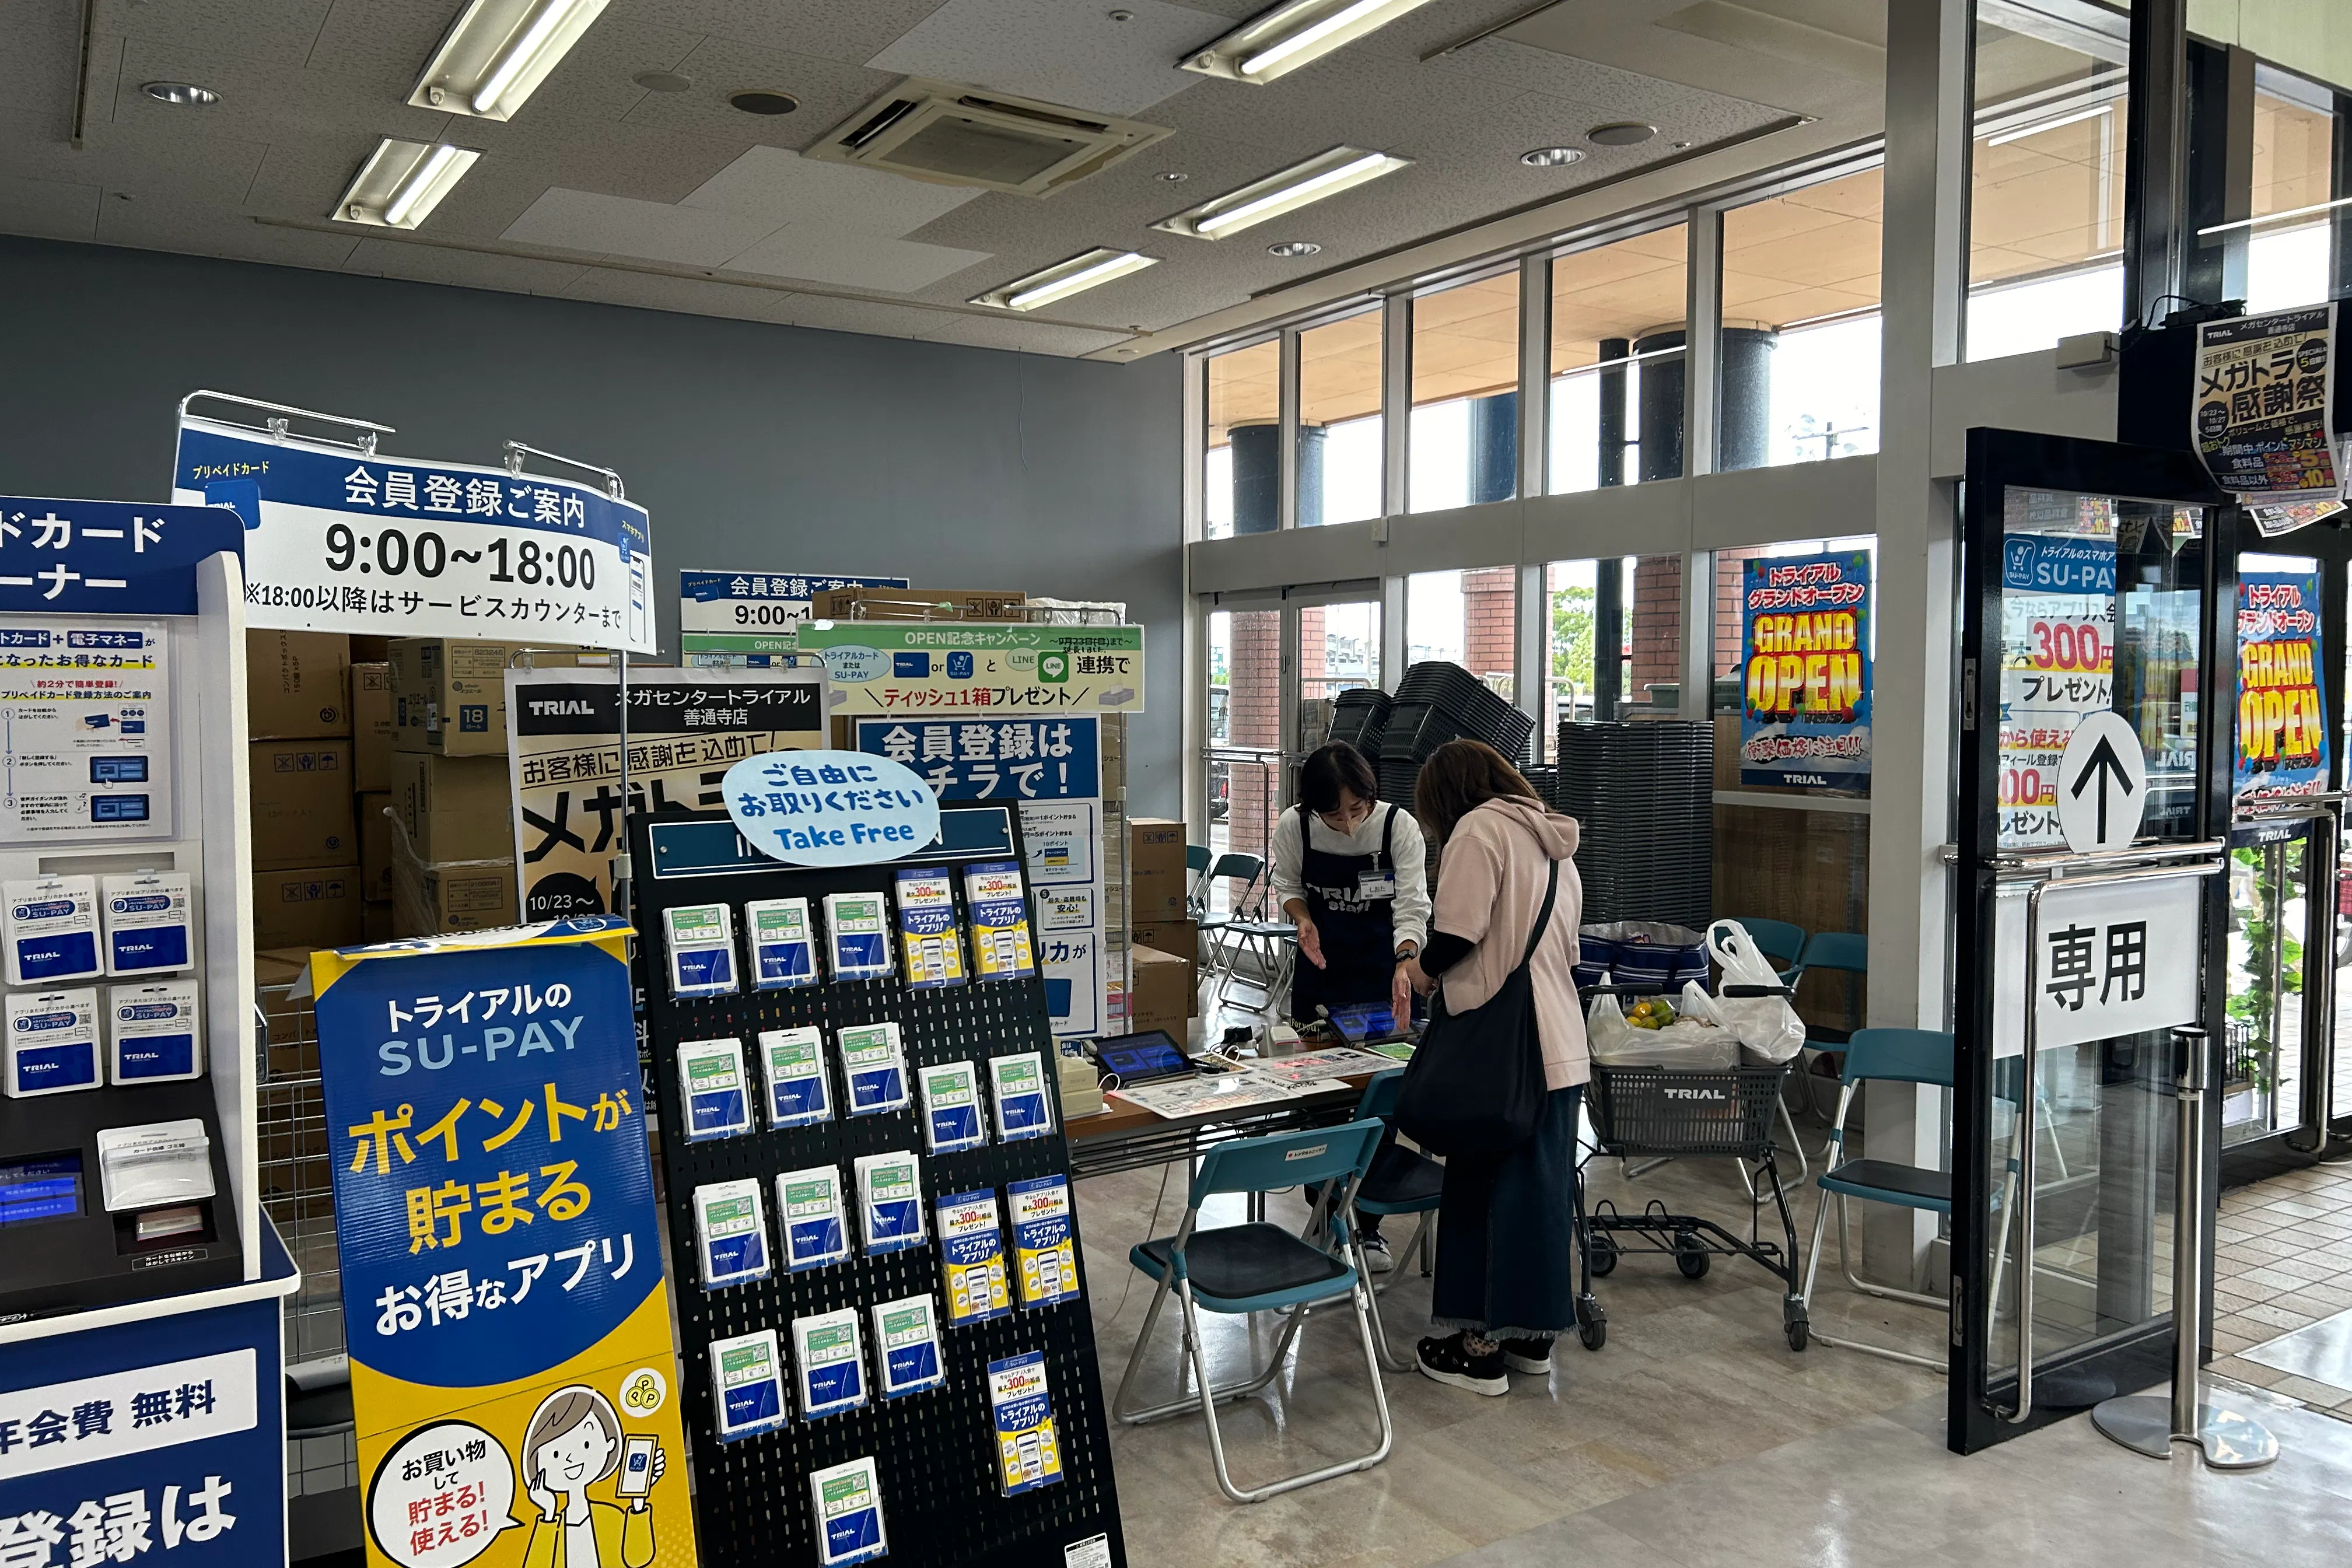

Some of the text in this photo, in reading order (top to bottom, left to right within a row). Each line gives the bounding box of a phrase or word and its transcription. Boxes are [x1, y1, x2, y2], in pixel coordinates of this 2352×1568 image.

[2241, 312, 2325, 331] メガセンタートライアル
[2207, 330, 2232, 339] TRIAL
[2199, 349, 2295, 398] メガトラ
[2232, 374, 2325, 424] 感謝祭
[2301, 450, 2318, 467] 5
[193, 461, 270, 480] プリペイドカード
[2305, 469, 2324, 487] 10
[344, 466, 585, 528] 会員登録ご案内
[1768, 562, 1842, 587] トライアル
[2009, 571, 2030, 580] SU-PAY
[1748, 583, 1866, 610] グランドオープン
[2249, 584, 2301, 608] トライアル
[245, 582, 621, 630] ※18:00以降はサービスカウンターまで
[2238, 609, 2315, 635] グランドオープン
[71, 632, 139, 646] 電子マネー
[145, 638, 155, 646] が
[905, 632, 1041, 645] OPEN記念キャンペーン
[1755, 611, 1857, 653] GRAND
[824, 651, 878, 660] トライアルカード
[1012, 656, 1035, 664] LINE
[932, 663, 944, 672] or
[987, 660, 996, 672] と
[1077, 656, 1130, 674] 連携で
[2242, 642, 2313, 688] GRAND
[834, 671, 869, 679] SU-PAY
[1746, 653, 1863, 713] OPEN
[1, 691, 152, 699] プリペイドカード登録方法のご案内
[614, 689, 811, 707] メガセンタートライアル
[2022, 675, 2112, 705] プレゼント!
[464, 709, 484, 723] 18
[529, 700, 594, 716] TRIAL
[684, 708, 748, 727] 善通寺店
[2241, 687, 2322, 759] OPEN
[883, 723, 1073, 764] 会員登録は
[1745, 736, 1861, 761] 衝撃価格に注目!!
[762, 764, 878, 786] ご自由に
[1783, 774, 1827, 785] TRIAL
[738, 789, 924, 817] お取りください
[774, 827, 845, 850] Take
[850, 823, 915, 844] Free
[2258, 830, 2292, 842] TRIAL
[32, 908, 69, 918] SU-PAY
[129, 902, 165, 911] SU-PAY
[979, 907, 1021, 919] トライアルの
[1057, 904, 1079, 913] 安心!
[907, 914, 950, 925] トライアルの
[989, 915, 1015, 926] アプリ!
[917, 923, 944, 933] アプリ!
[118, 943, 153, 952] TRIAL
[24, 951, 61, 961] TRIAL
[2046, 921, 2147, 1012] 専用
[136, 1010, 173, 1019] SU-PAY
[388, 984, 572, 1034] トライアルの
[33, 1020, 71, 1030] SU-PAY
[379, 1016, 584, 1076] SU-PAY
[124, 1052, 159, 1060] TRIAL
[22, 1062, 60, 1072] TRIAL
[856, 1084, 880, 1092] TRIAL
[1664, 1088, 1726, 1100] TRIAL
[695, 1106, 720, 1114] TRIAL
[348, 1082, 631, 1176] ポイントが
[936, 1120, 957, 1128] TRIAL
[407, 1159, 592, 1255] 貯まる
[1031, 1207, 1057, 1217] プレゼント!
[958, 1221, 986, 1232] プレゼント!
[1024, 1224, 1066, 1240] トライアルの
[794, 1234, 819, 1243] TRIAL
[951, 1238, 996, 1255] トライアルの
[1034, 1233, 1060, 1248] アプリ!
[714, 1251, 738, 1260] TRIAL
[962, 1248, 990, 1264] アプリ!
[376, 1233, 635, 1336] お得なアプリ
[892, 1360, 915, 1370] TRIAL
[812, 1379, 836, 1390] TRIAL
[1006, 1385, 1034, 1398] プレゼント!
[131, 1379, 216, 1429] 無料
[729, 1399, 754, 1410] TRIAL
[1000, 1403, 1045, 1422] トライアルの
[1012, 1413, 1040, 1430] アプリ!
[401, 1438, 487, 1482] お買い物
[433, 1471, 459, 1490] して
[408, 1480, 485, 1527] 貯まる!
[410, 1513, 489, 1557] 使える!
[831, 1528, 855, 1540] TRIAL
